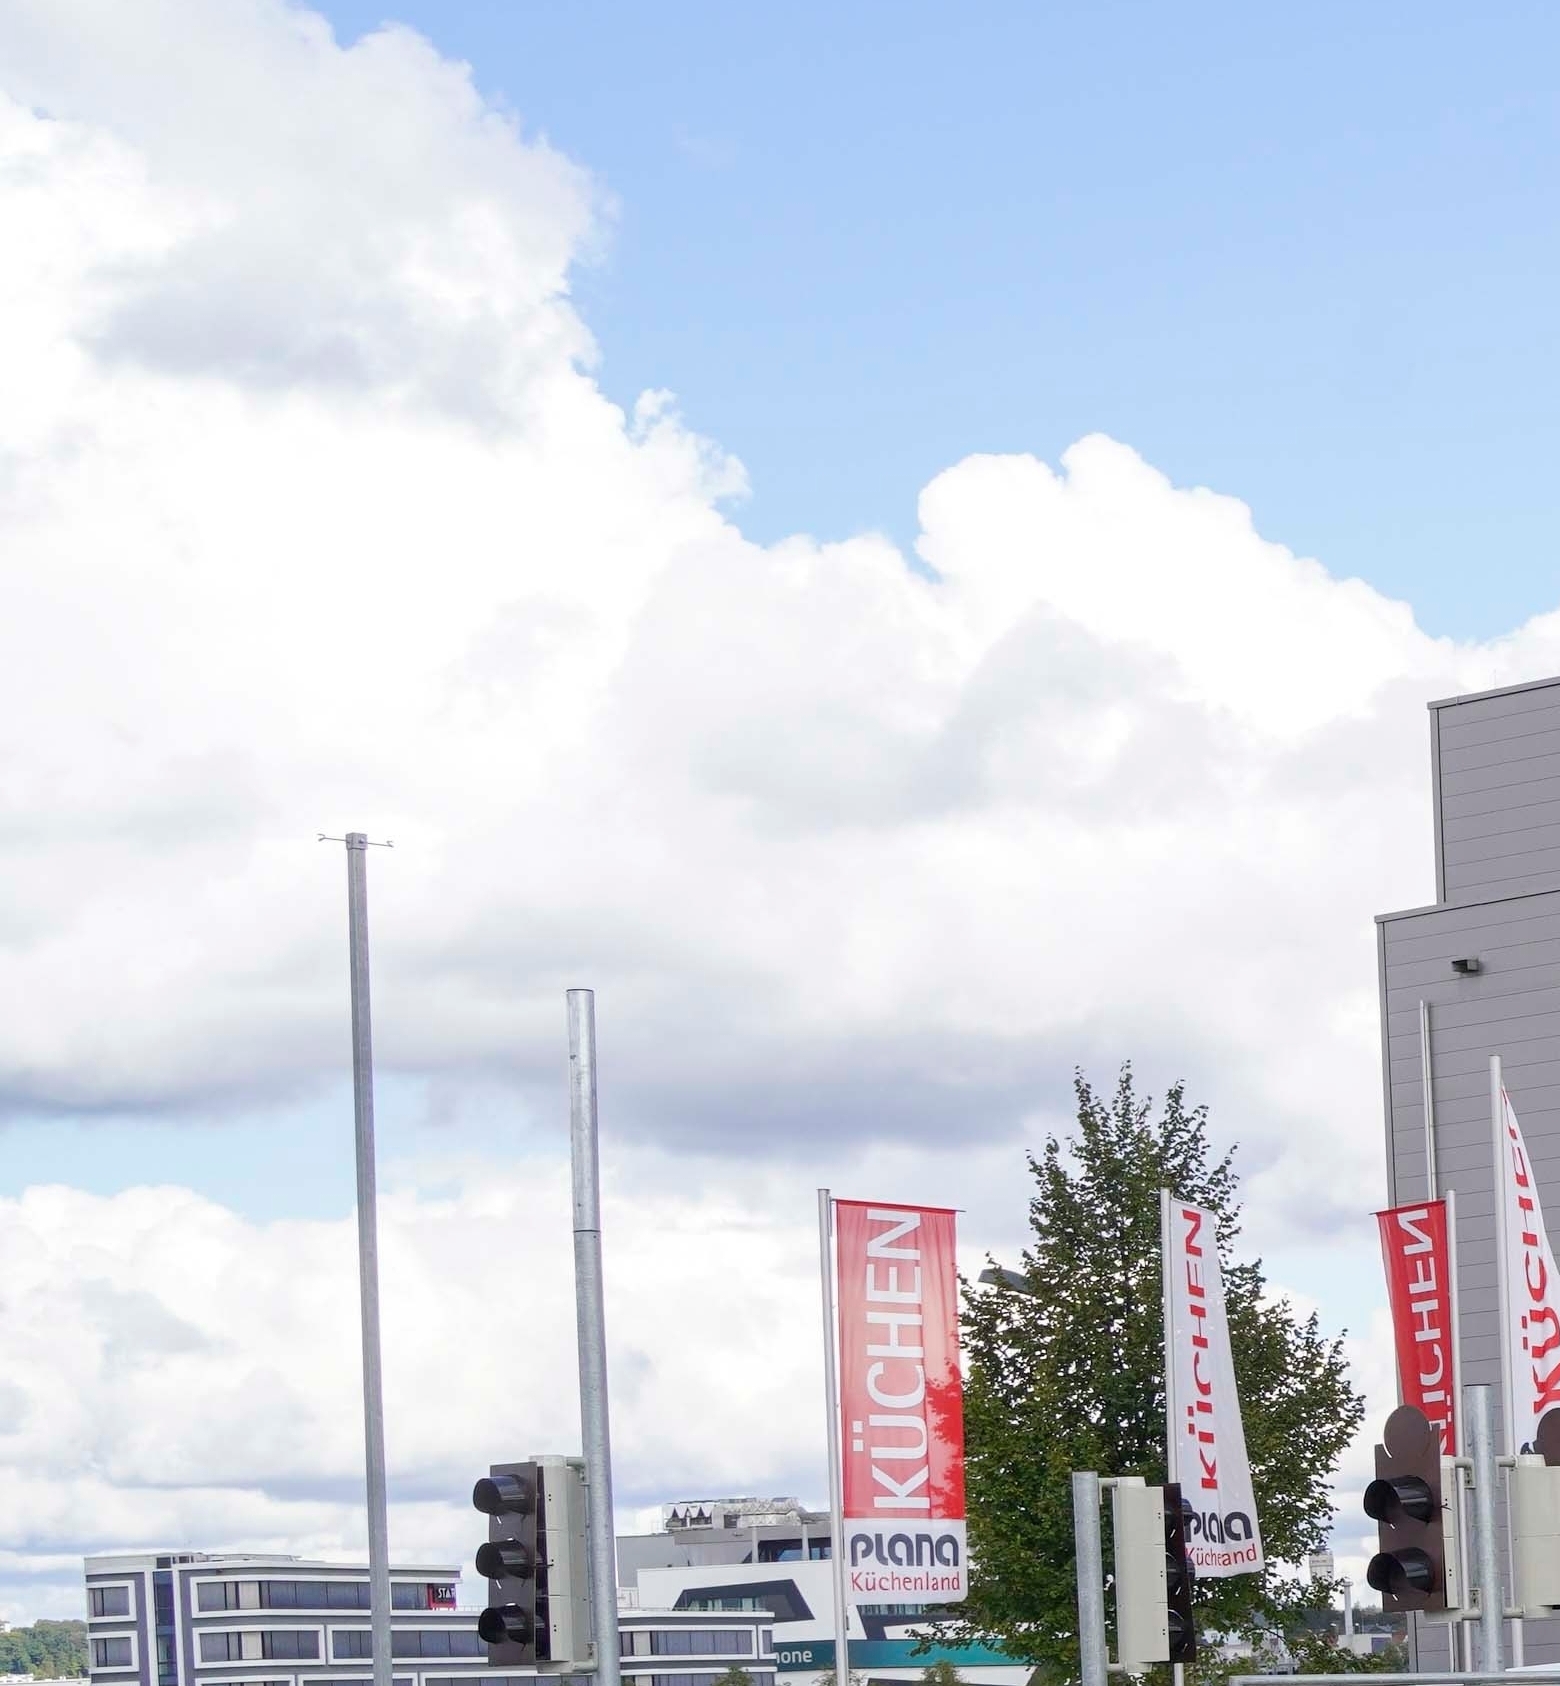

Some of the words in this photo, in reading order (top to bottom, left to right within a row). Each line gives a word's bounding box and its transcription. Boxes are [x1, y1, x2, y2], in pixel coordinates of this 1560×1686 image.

[852, 1208, 931, 1510] KÜCHEN
[850, 1532, 959, 1567] plana
[851, 1570, 960, 1592] Küchenland
